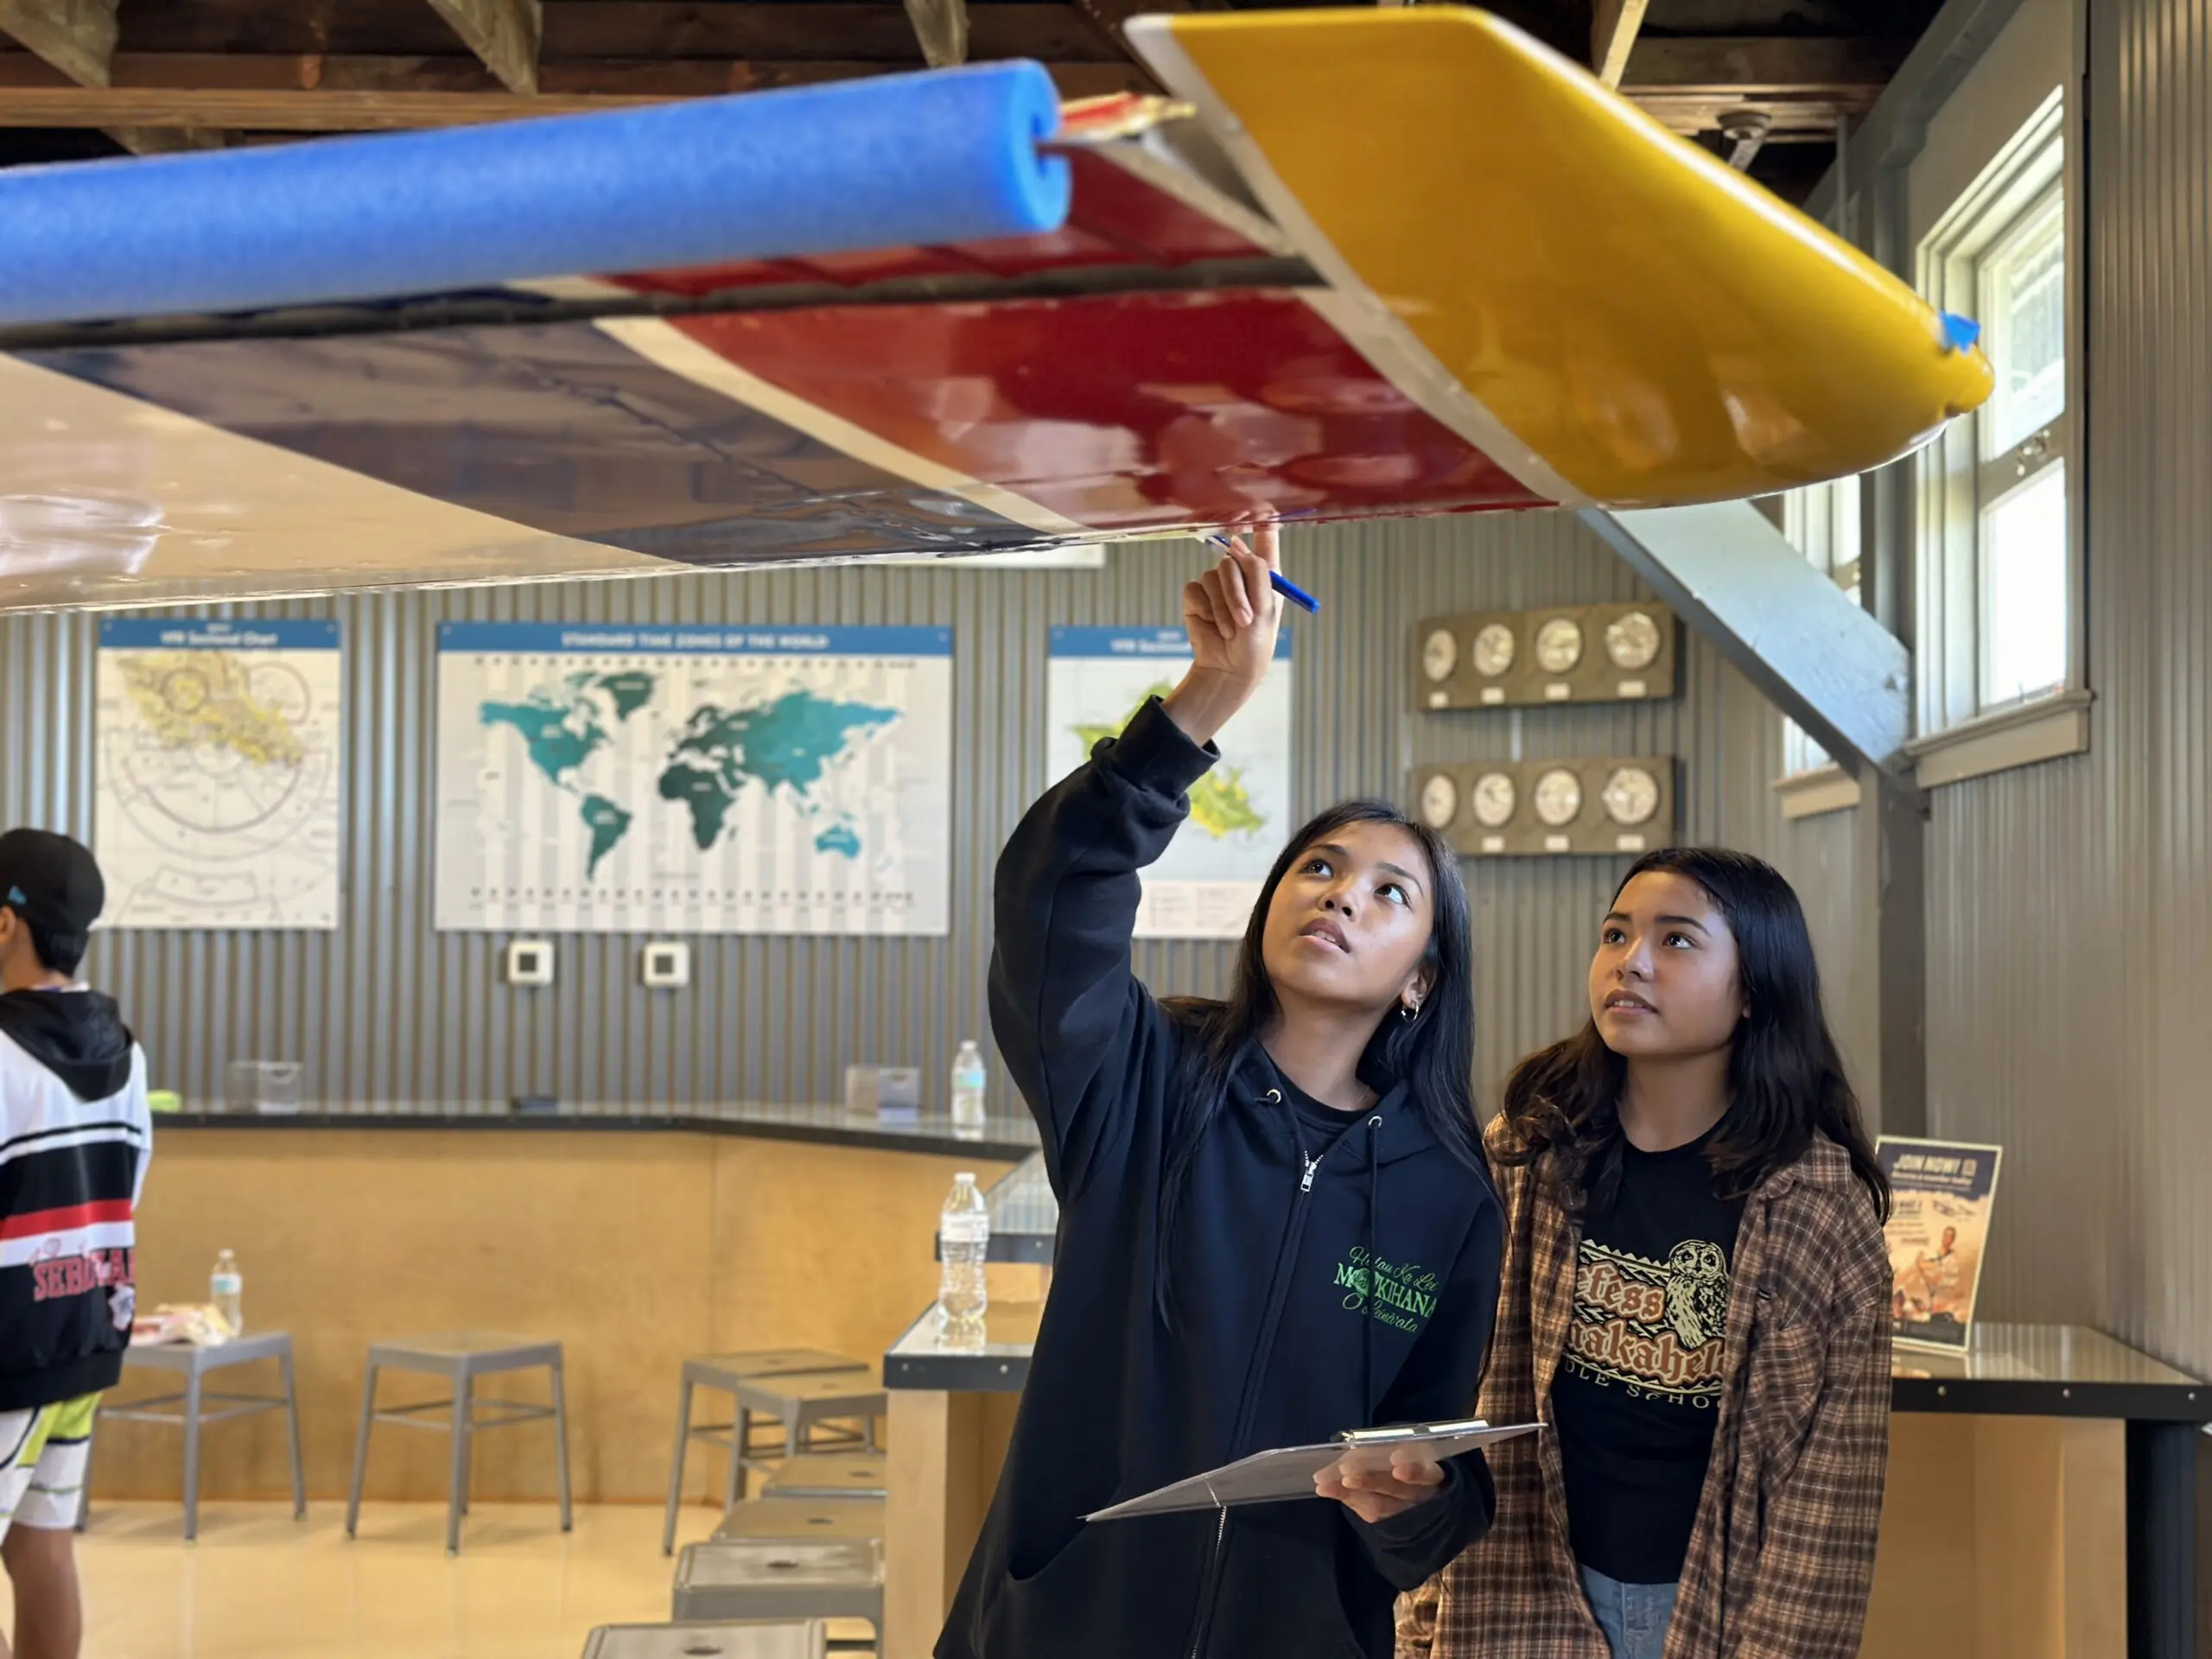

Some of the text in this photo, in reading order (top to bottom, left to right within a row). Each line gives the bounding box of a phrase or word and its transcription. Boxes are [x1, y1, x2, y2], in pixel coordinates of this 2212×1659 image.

[748, 633, 775, 649] THE
[779, 633, 829, 649] WORLD
[1893, 1154, 1925, 1170] JOIN
